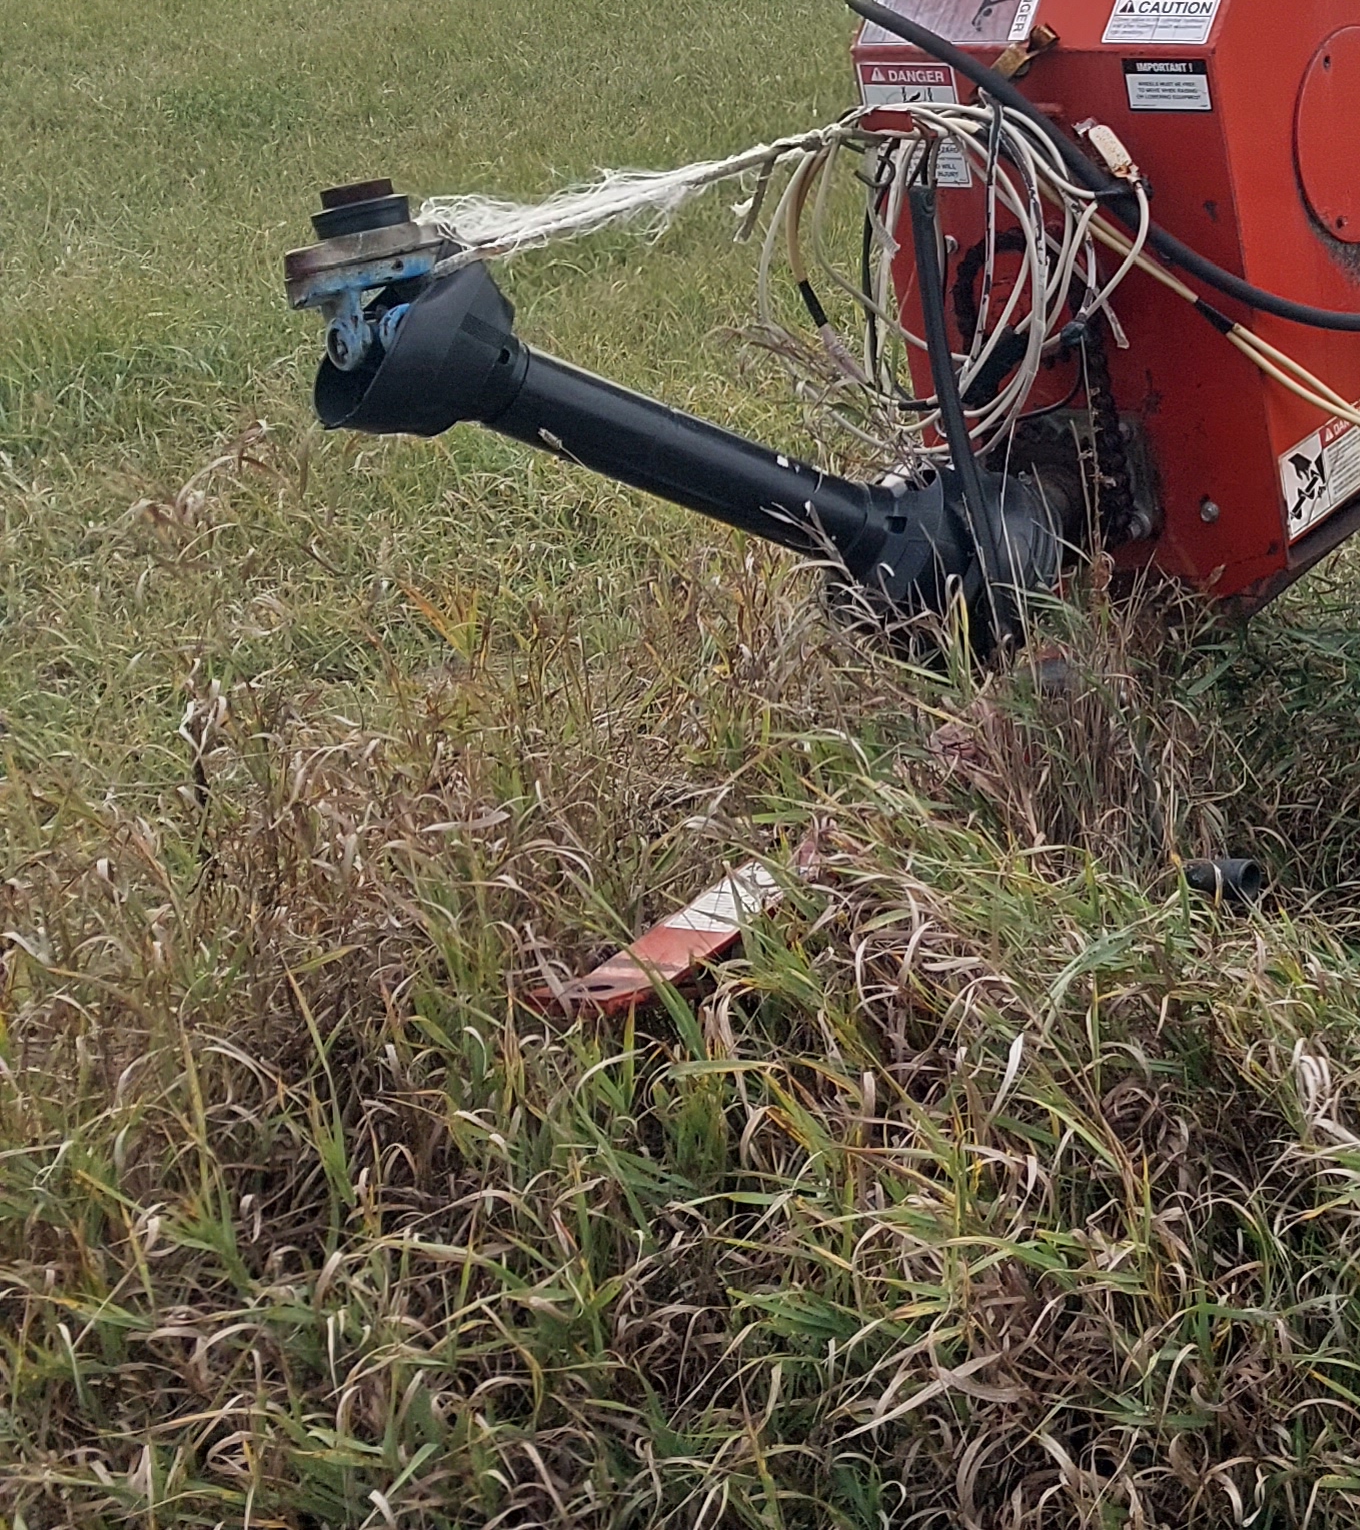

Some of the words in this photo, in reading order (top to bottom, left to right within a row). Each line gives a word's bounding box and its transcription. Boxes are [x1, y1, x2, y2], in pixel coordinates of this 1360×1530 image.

[1139, 1, 1213, 14] CAUTION
[1136, 62, 1187, 72] IMPORTANT
[888, 70, 944, 83] DANGER
